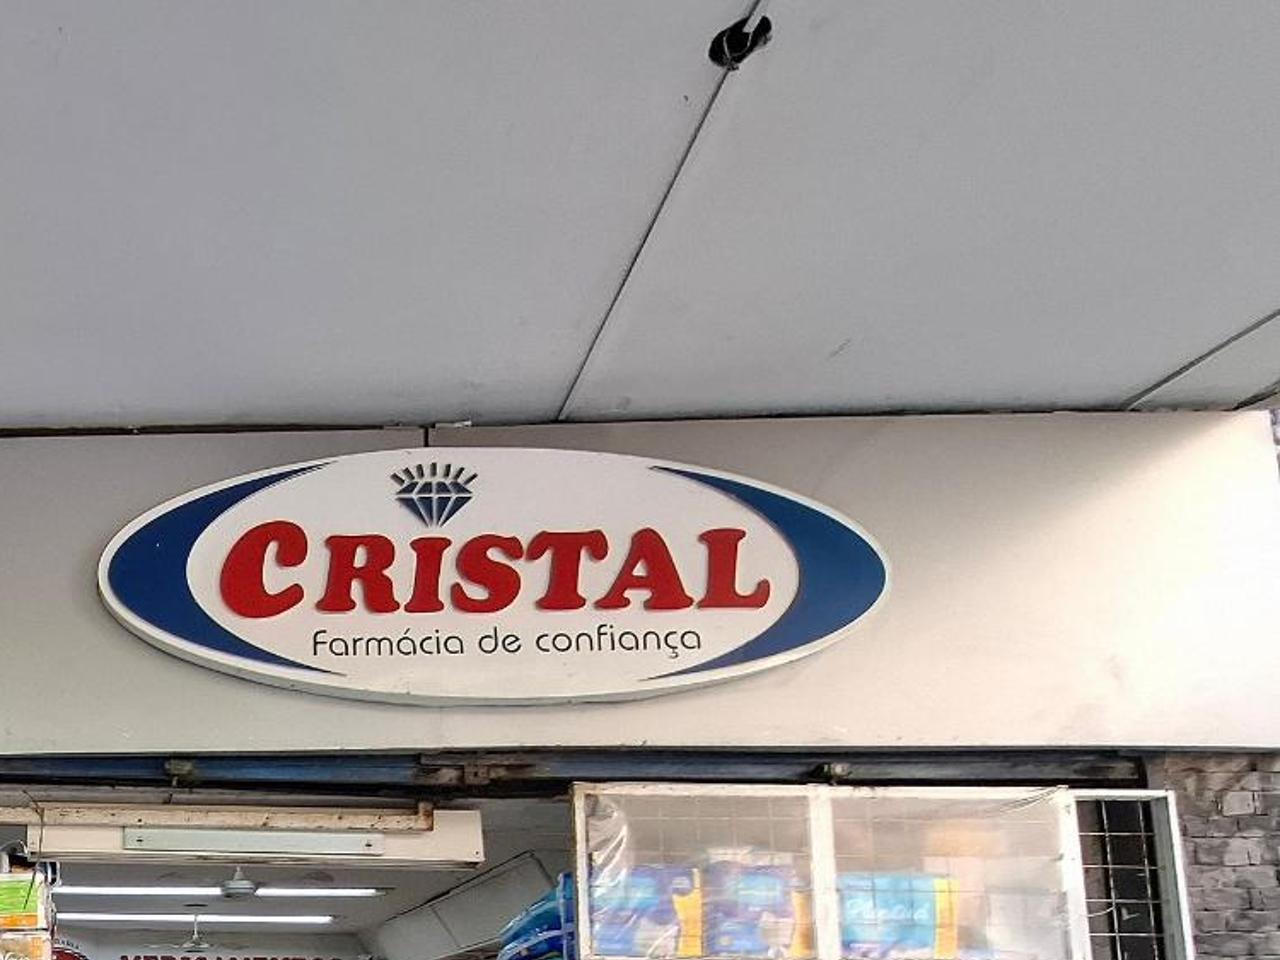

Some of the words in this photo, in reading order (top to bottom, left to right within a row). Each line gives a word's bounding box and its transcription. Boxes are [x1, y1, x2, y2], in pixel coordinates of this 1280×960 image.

[218, 519, 771, 619] CRISTAL
[312, 626, 464, 658] Farmácia
[479, 624, 522, 655] de
[535, 622, 702, 660] confiança
